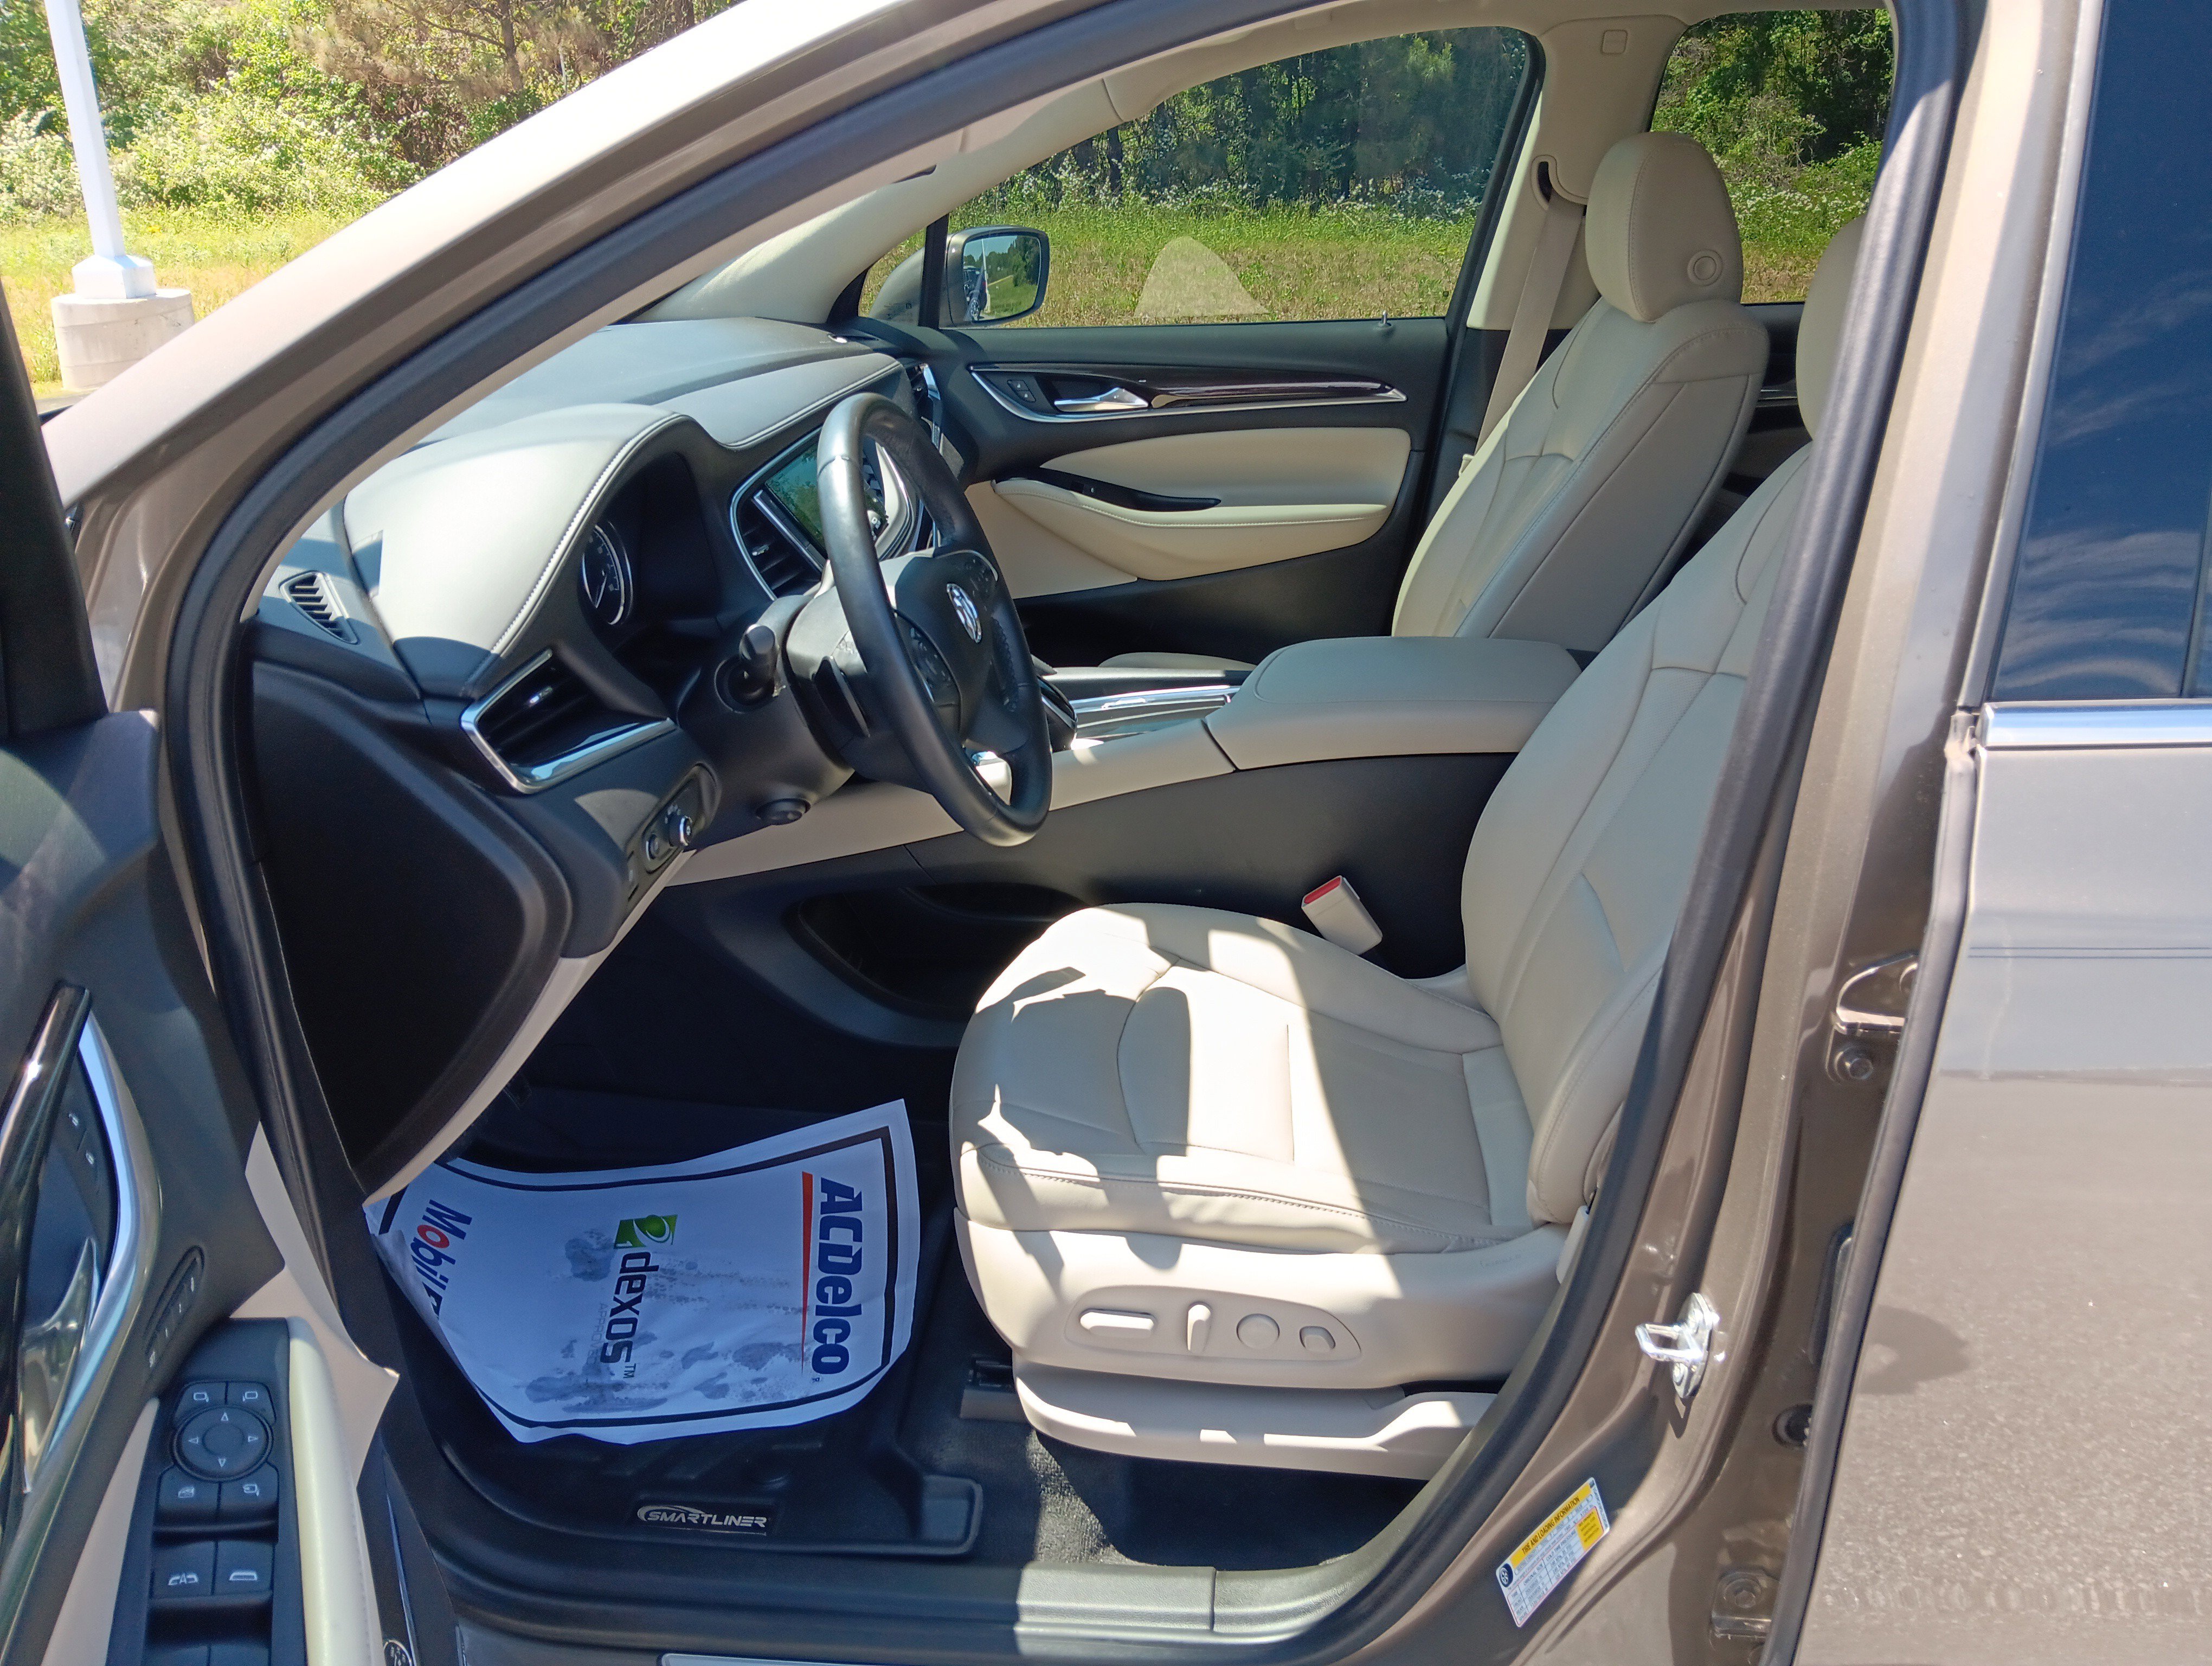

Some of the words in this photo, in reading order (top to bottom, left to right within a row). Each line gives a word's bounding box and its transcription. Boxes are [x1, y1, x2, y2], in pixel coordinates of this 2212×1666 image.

[410, 1199, 473, 1291] Mobil
[811, 1177, 863, 1374] ACDelco
[647, 1510, 768, 1528] SMARTLINER
[1538, 1519, 1555, 1540] LOADING
